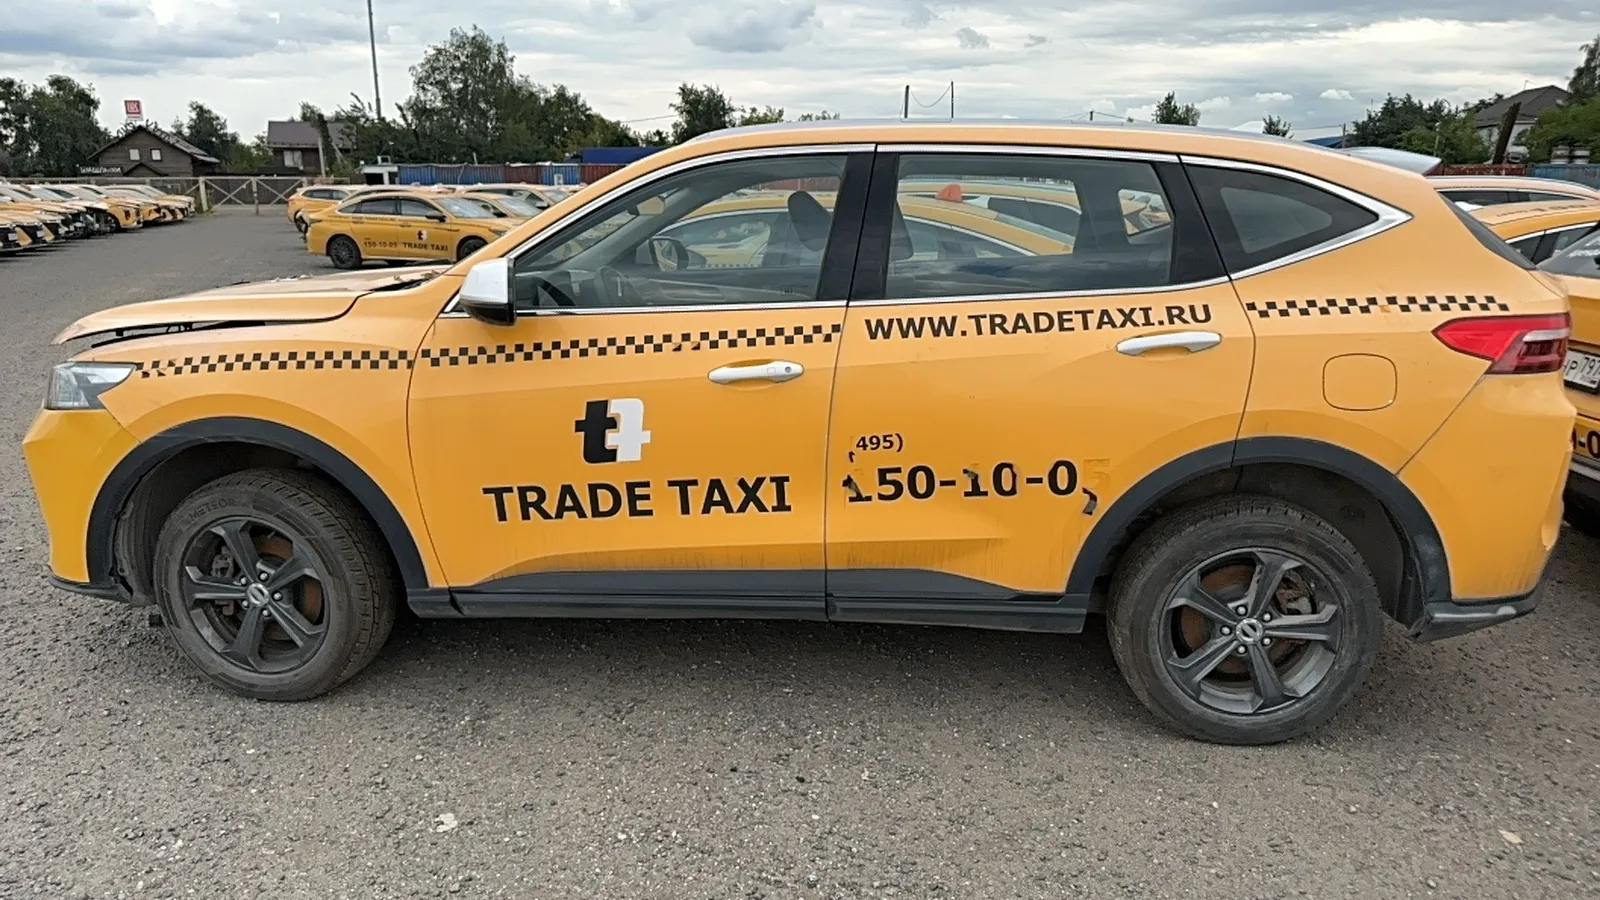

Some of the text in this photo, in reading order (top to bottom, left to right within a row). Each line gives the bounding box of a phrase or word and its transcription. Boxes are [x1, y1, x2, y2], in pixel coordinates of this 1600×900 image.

[402, 242, 448, 252] TRADE TAXI
[865, 304, 1212, 340] WWW.TRADETAXI.RU
[850, 433, 903, 453] 495)
[482, 475, 792, 522] TRADE TAXI
